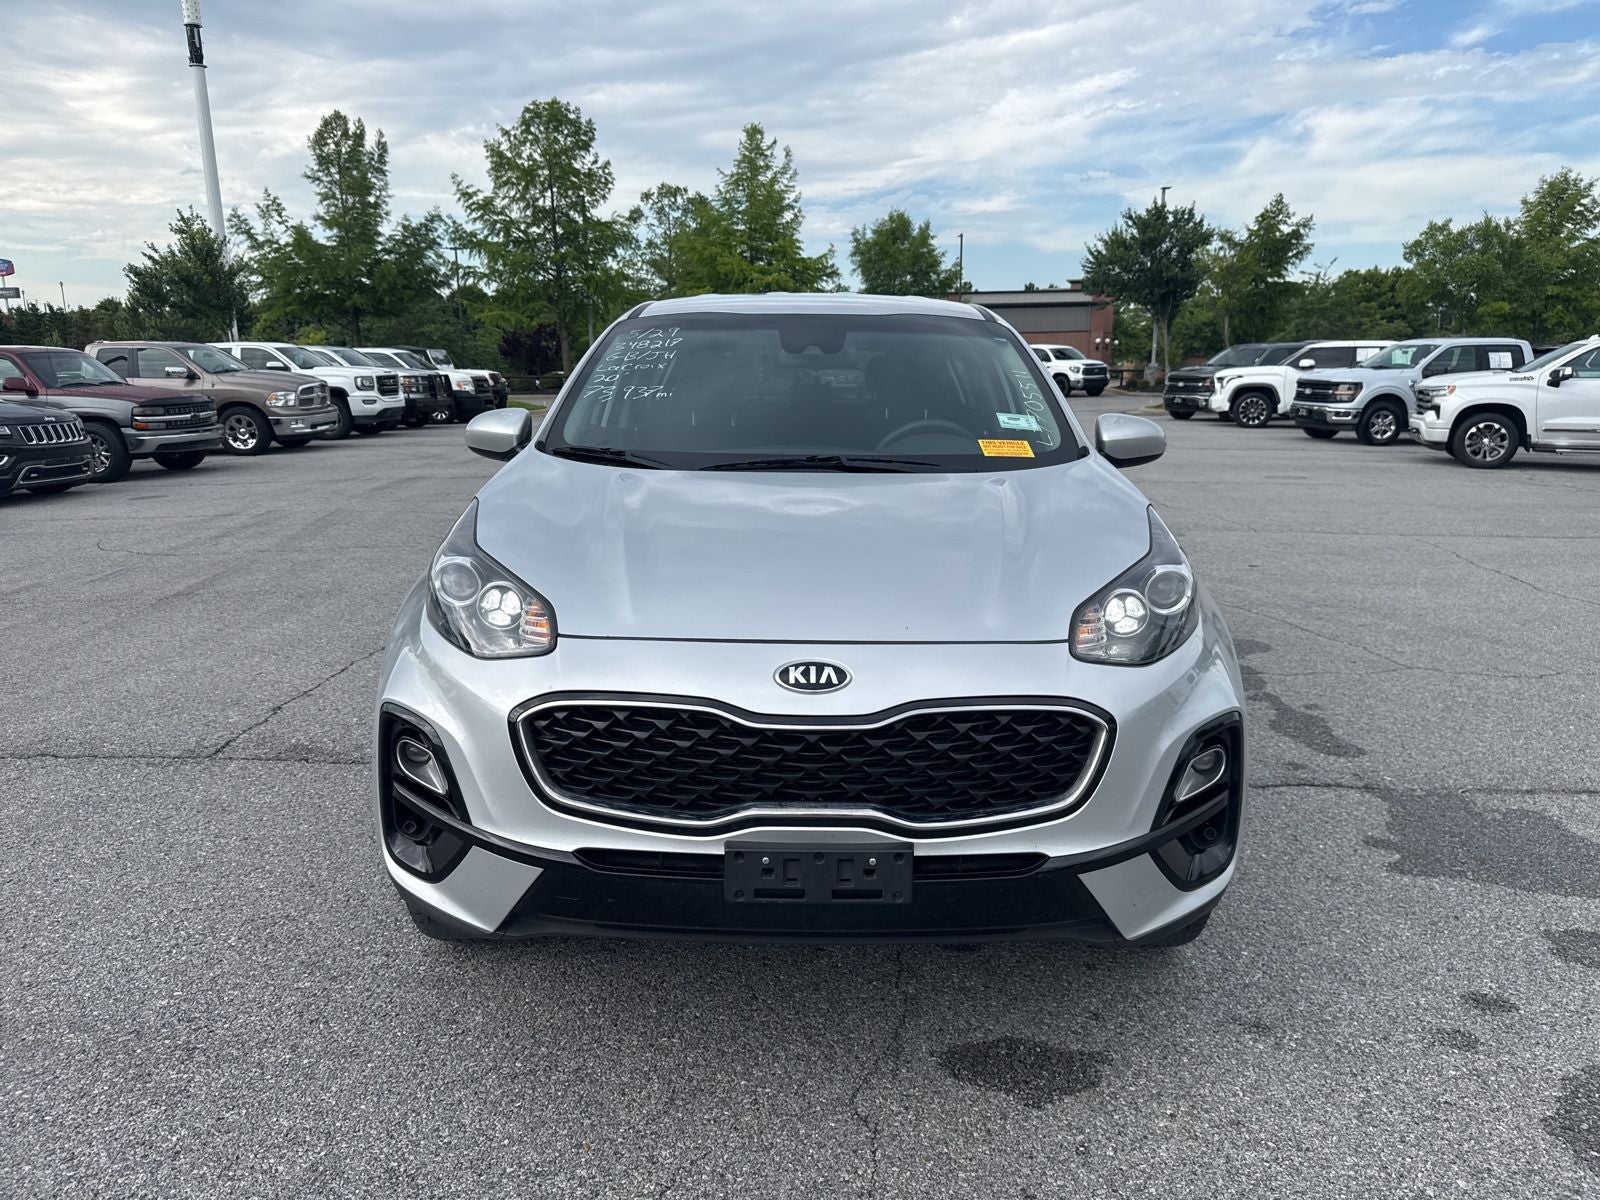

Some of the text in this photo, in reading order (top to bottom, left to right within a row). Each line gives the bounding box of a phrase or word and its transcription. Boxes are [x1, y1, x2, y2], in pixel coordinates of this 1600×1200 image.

[627, 327, 681, 339] 5/29
[615, 338, 683, 350] 348217
[788, 665, 839, 684] KIA
